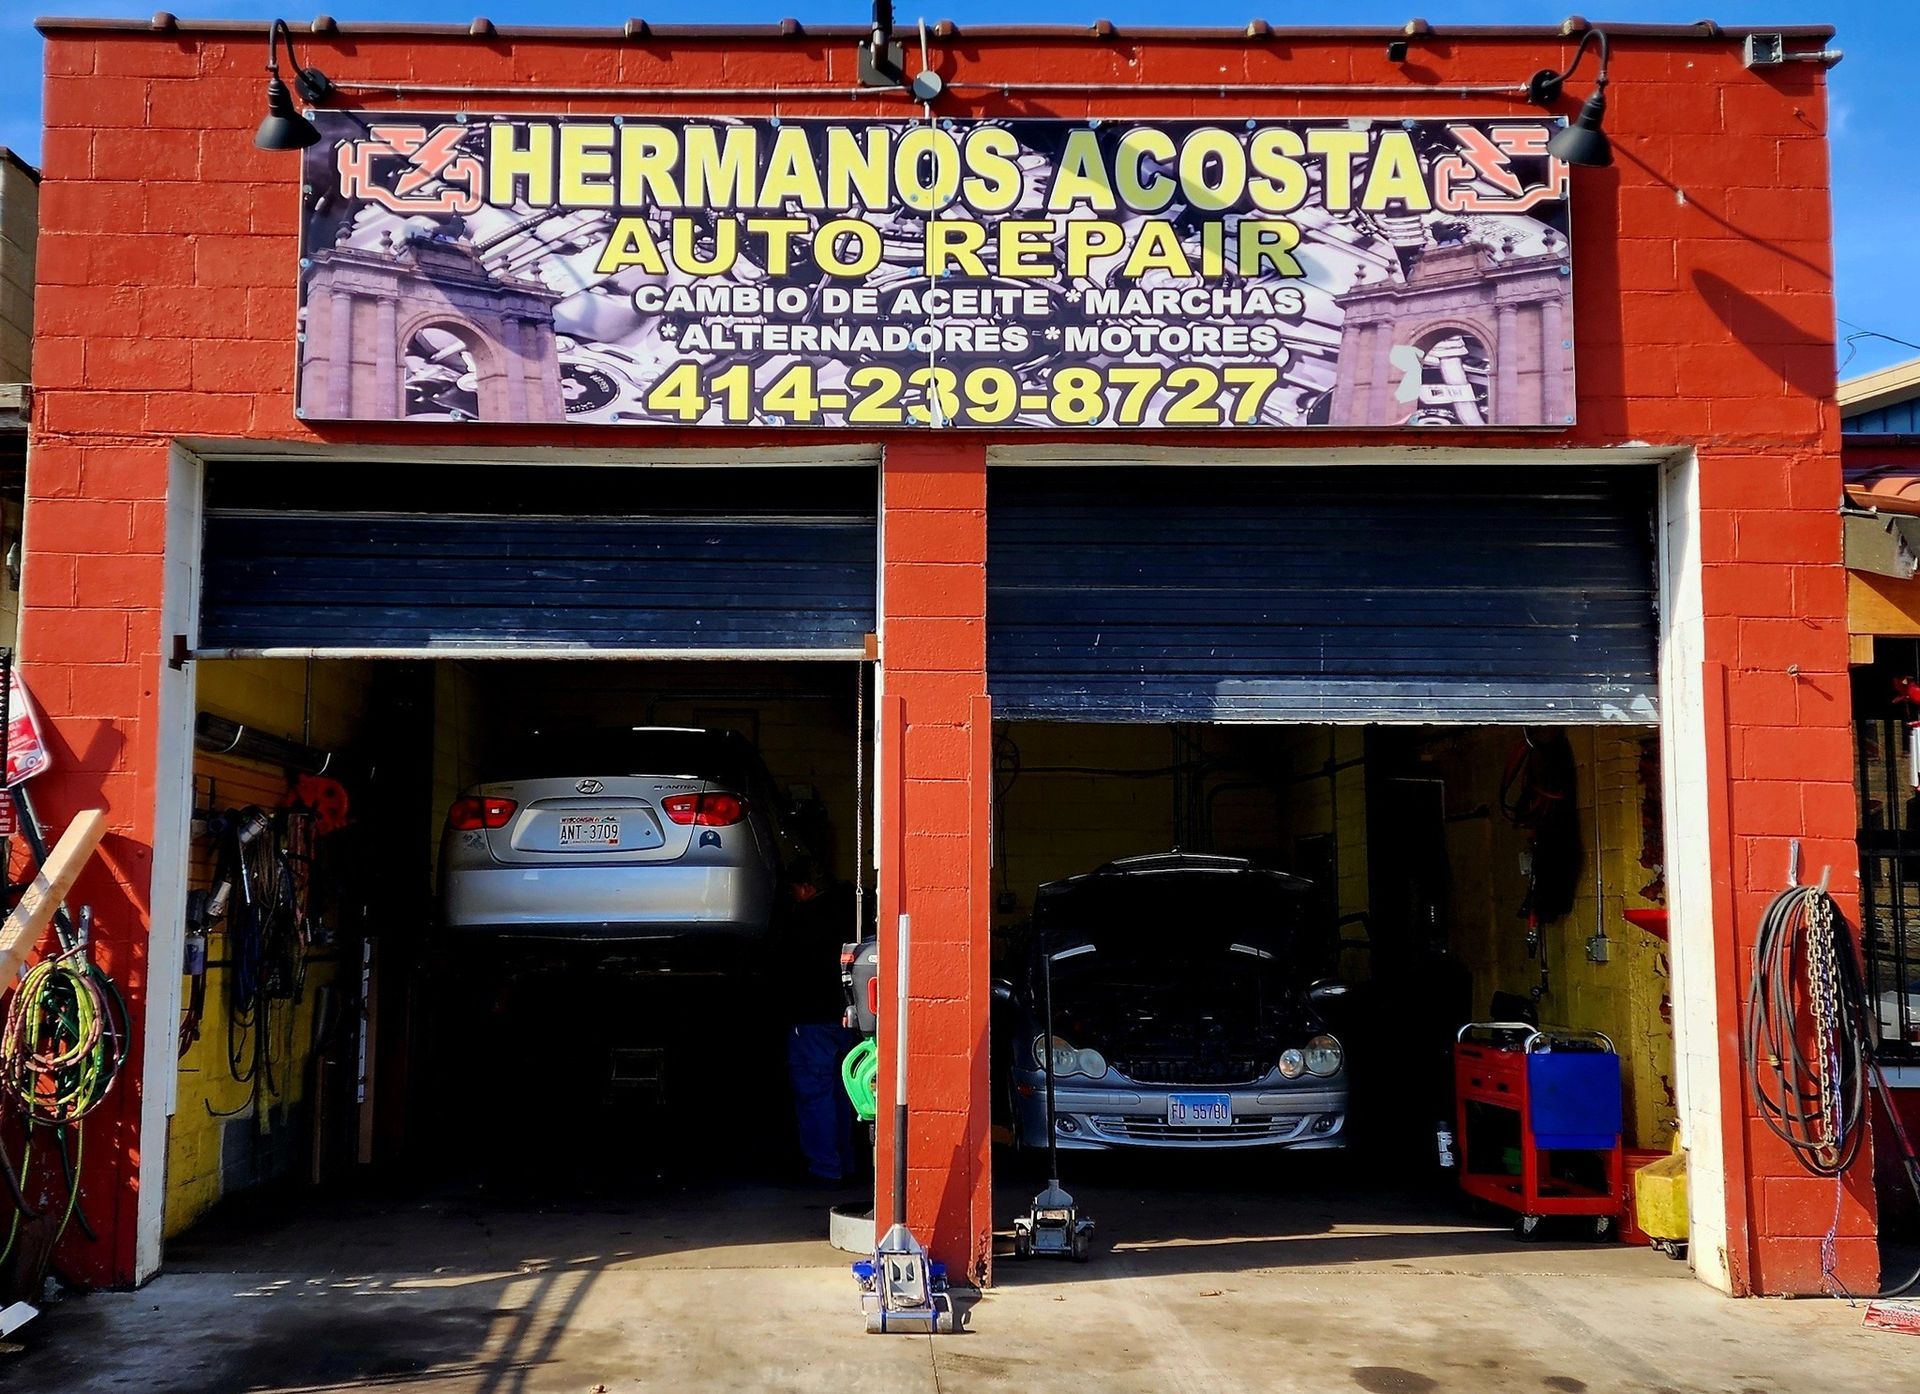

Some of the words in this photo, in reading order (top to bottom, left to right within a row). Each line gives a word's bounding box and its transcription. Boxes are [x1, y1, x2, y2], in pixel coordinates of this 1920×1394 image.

[489, 124, 1020, 212] HERMANOS
[1048, 126, 1433, 212] ACOSTA
[595, 217, 884, 277] AUTO
[925, 219, 1303, 278] REPAIR
[634, 285, 820, 316] CAMBIO
[823, 286, 878, 315] DE
[893, 287, 1050, 316] ACEITE
[647, 364, 1280, 425] 414-239-8727
[1171, 1103, 1186, 1120] FD
[1193, 1103, 1228, 1120] 55780
